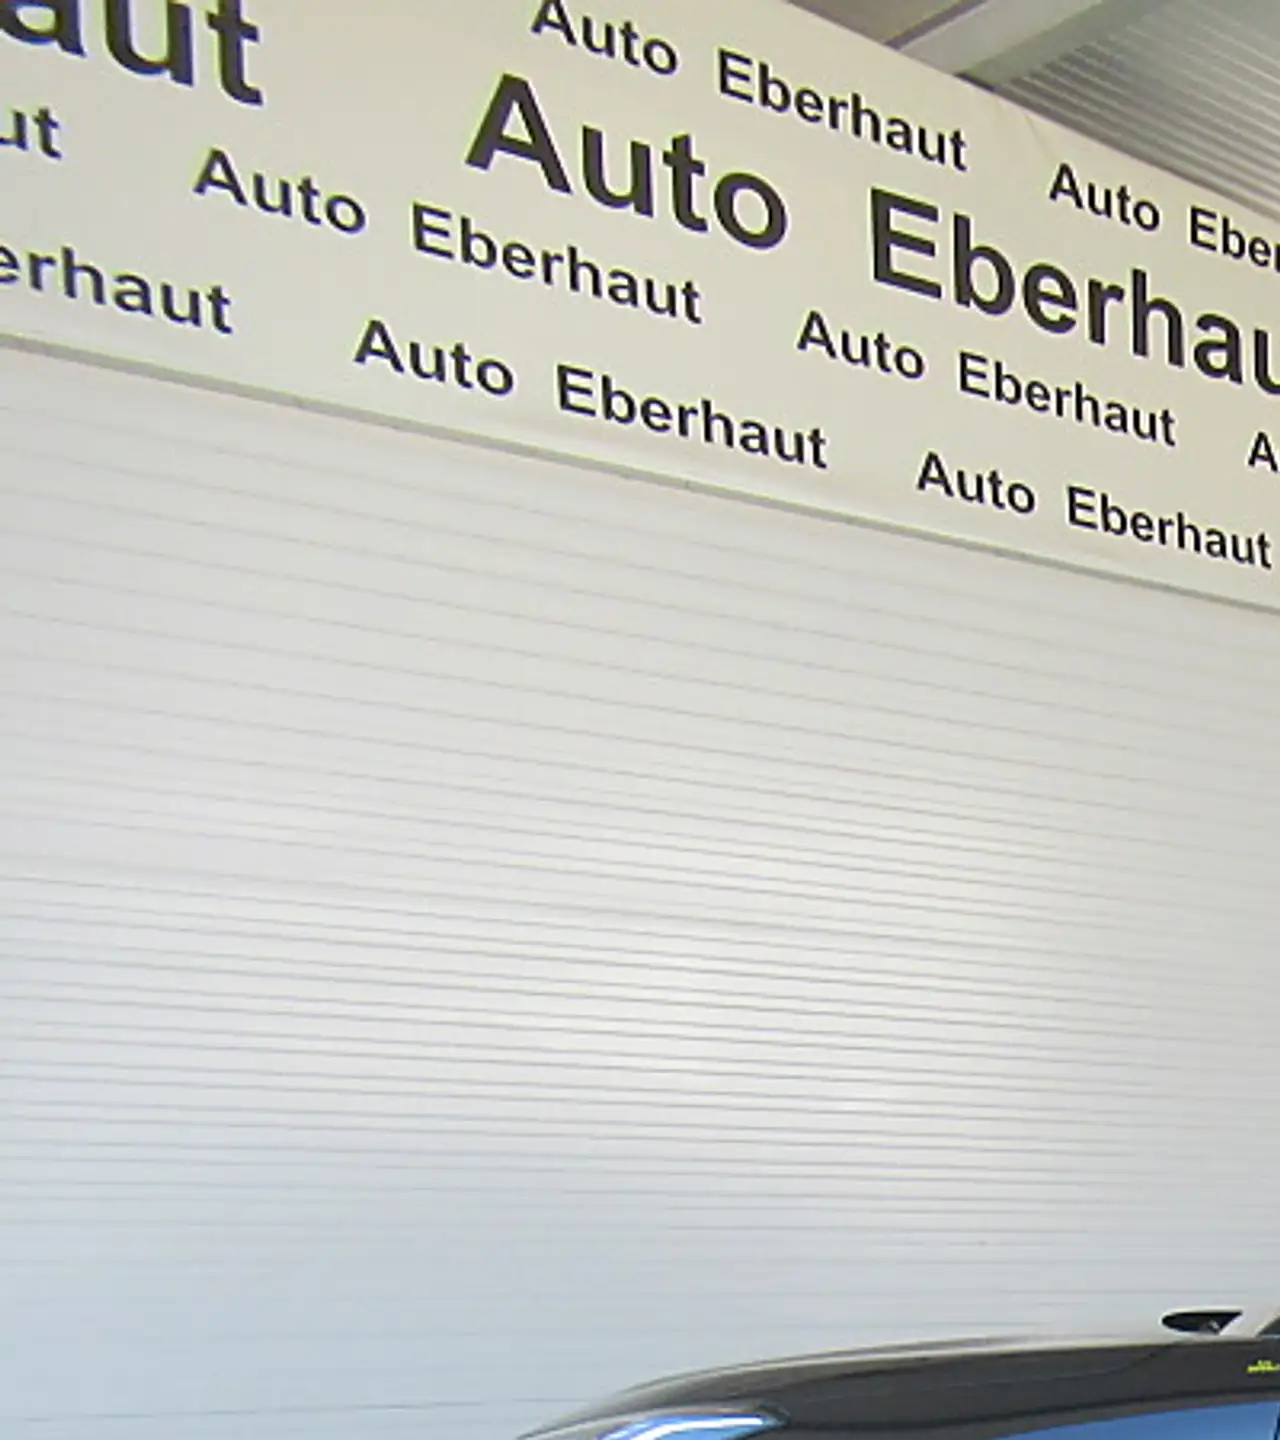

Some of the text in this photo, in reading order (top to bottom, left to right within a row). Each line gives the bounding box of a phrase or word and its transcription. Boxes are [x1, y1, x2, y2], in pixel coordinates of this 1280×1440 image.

[531, 0, 967, 172] Auto Eberhaut
[465, 73, 787, 250] Auto
[1049, 163, 1160, 232] Auto
[193, 149, 702, 325] Auto Eberhaut
[354, 319, 827, 469] Auto Eberhaut
[797, 310, 1176, 447] Auto Eberhaut
[917, 451, 1272, 570] Auto Eberhaut
